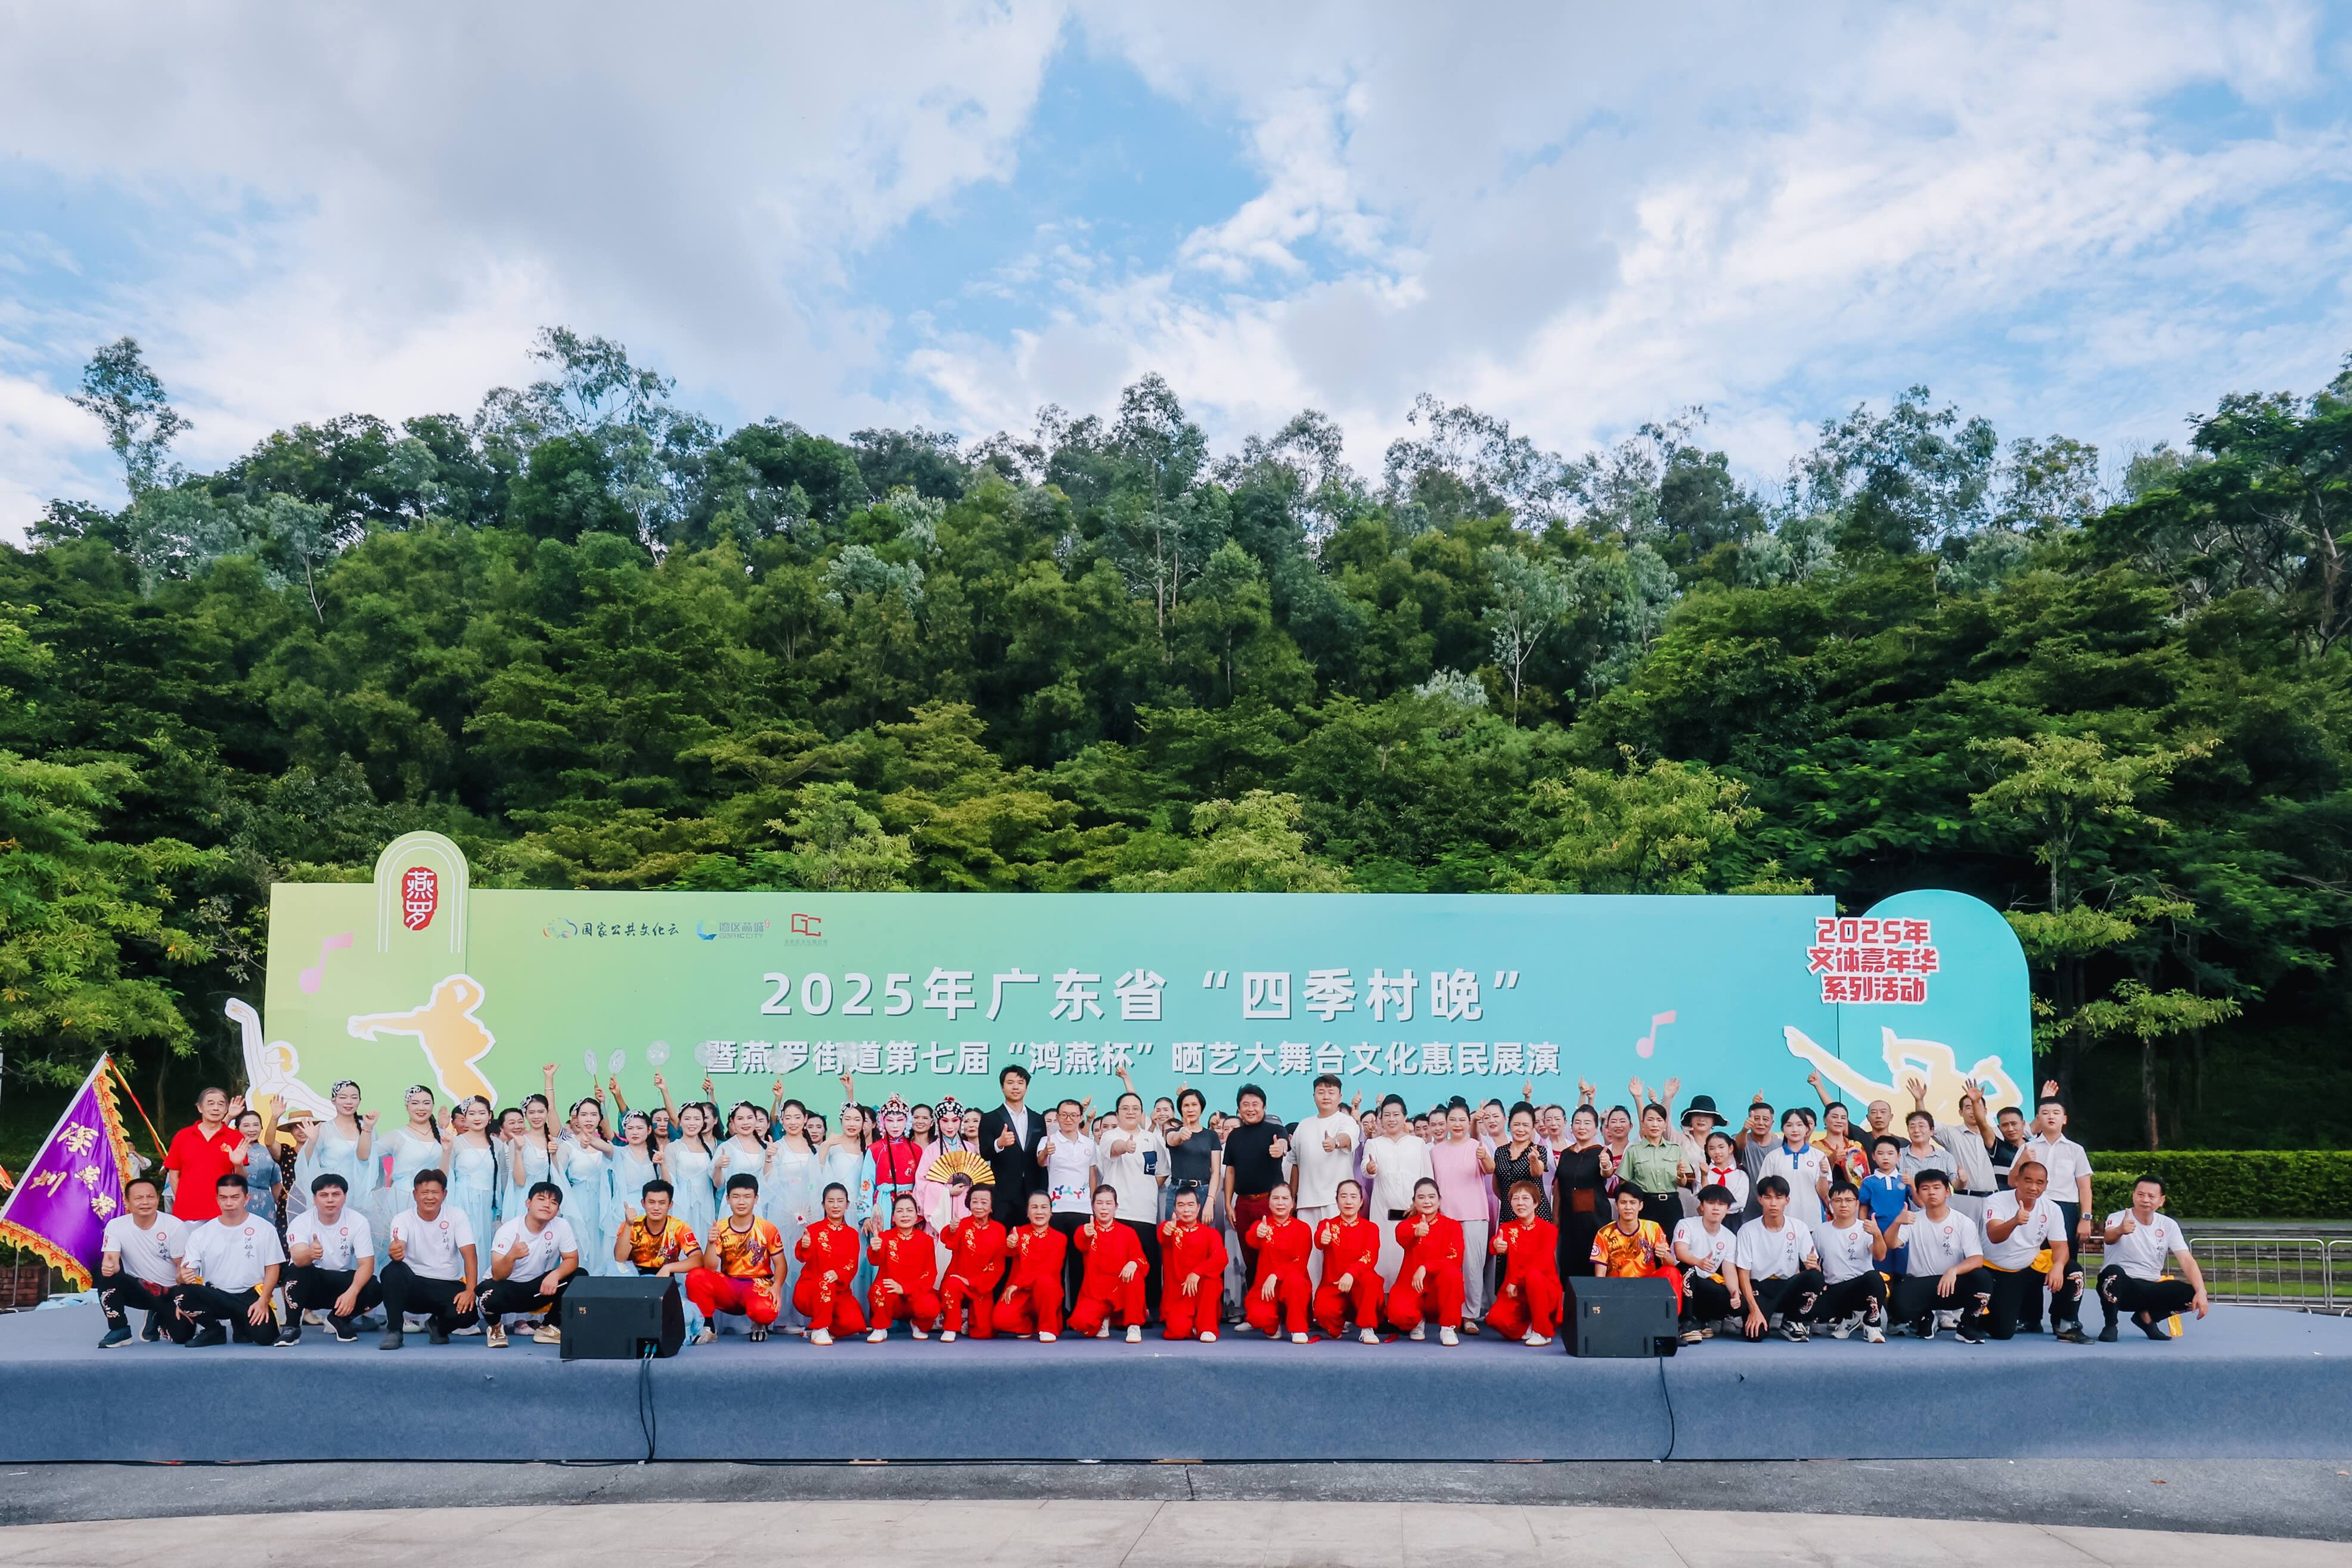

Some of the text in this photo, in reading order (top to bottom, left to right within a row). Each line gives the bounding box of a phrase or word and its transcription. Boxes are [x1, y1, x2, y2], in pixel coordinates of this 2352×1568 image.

[406, 870, 435, 930] 燕罗
[582, 922, 679, 937] 国家公共文化云
[1817, 920, 1929, 944] 2025年
[1809, 948, 1938, 973] 文体嘉年华
[1823, 976, 1926, 1002] 系列活动
